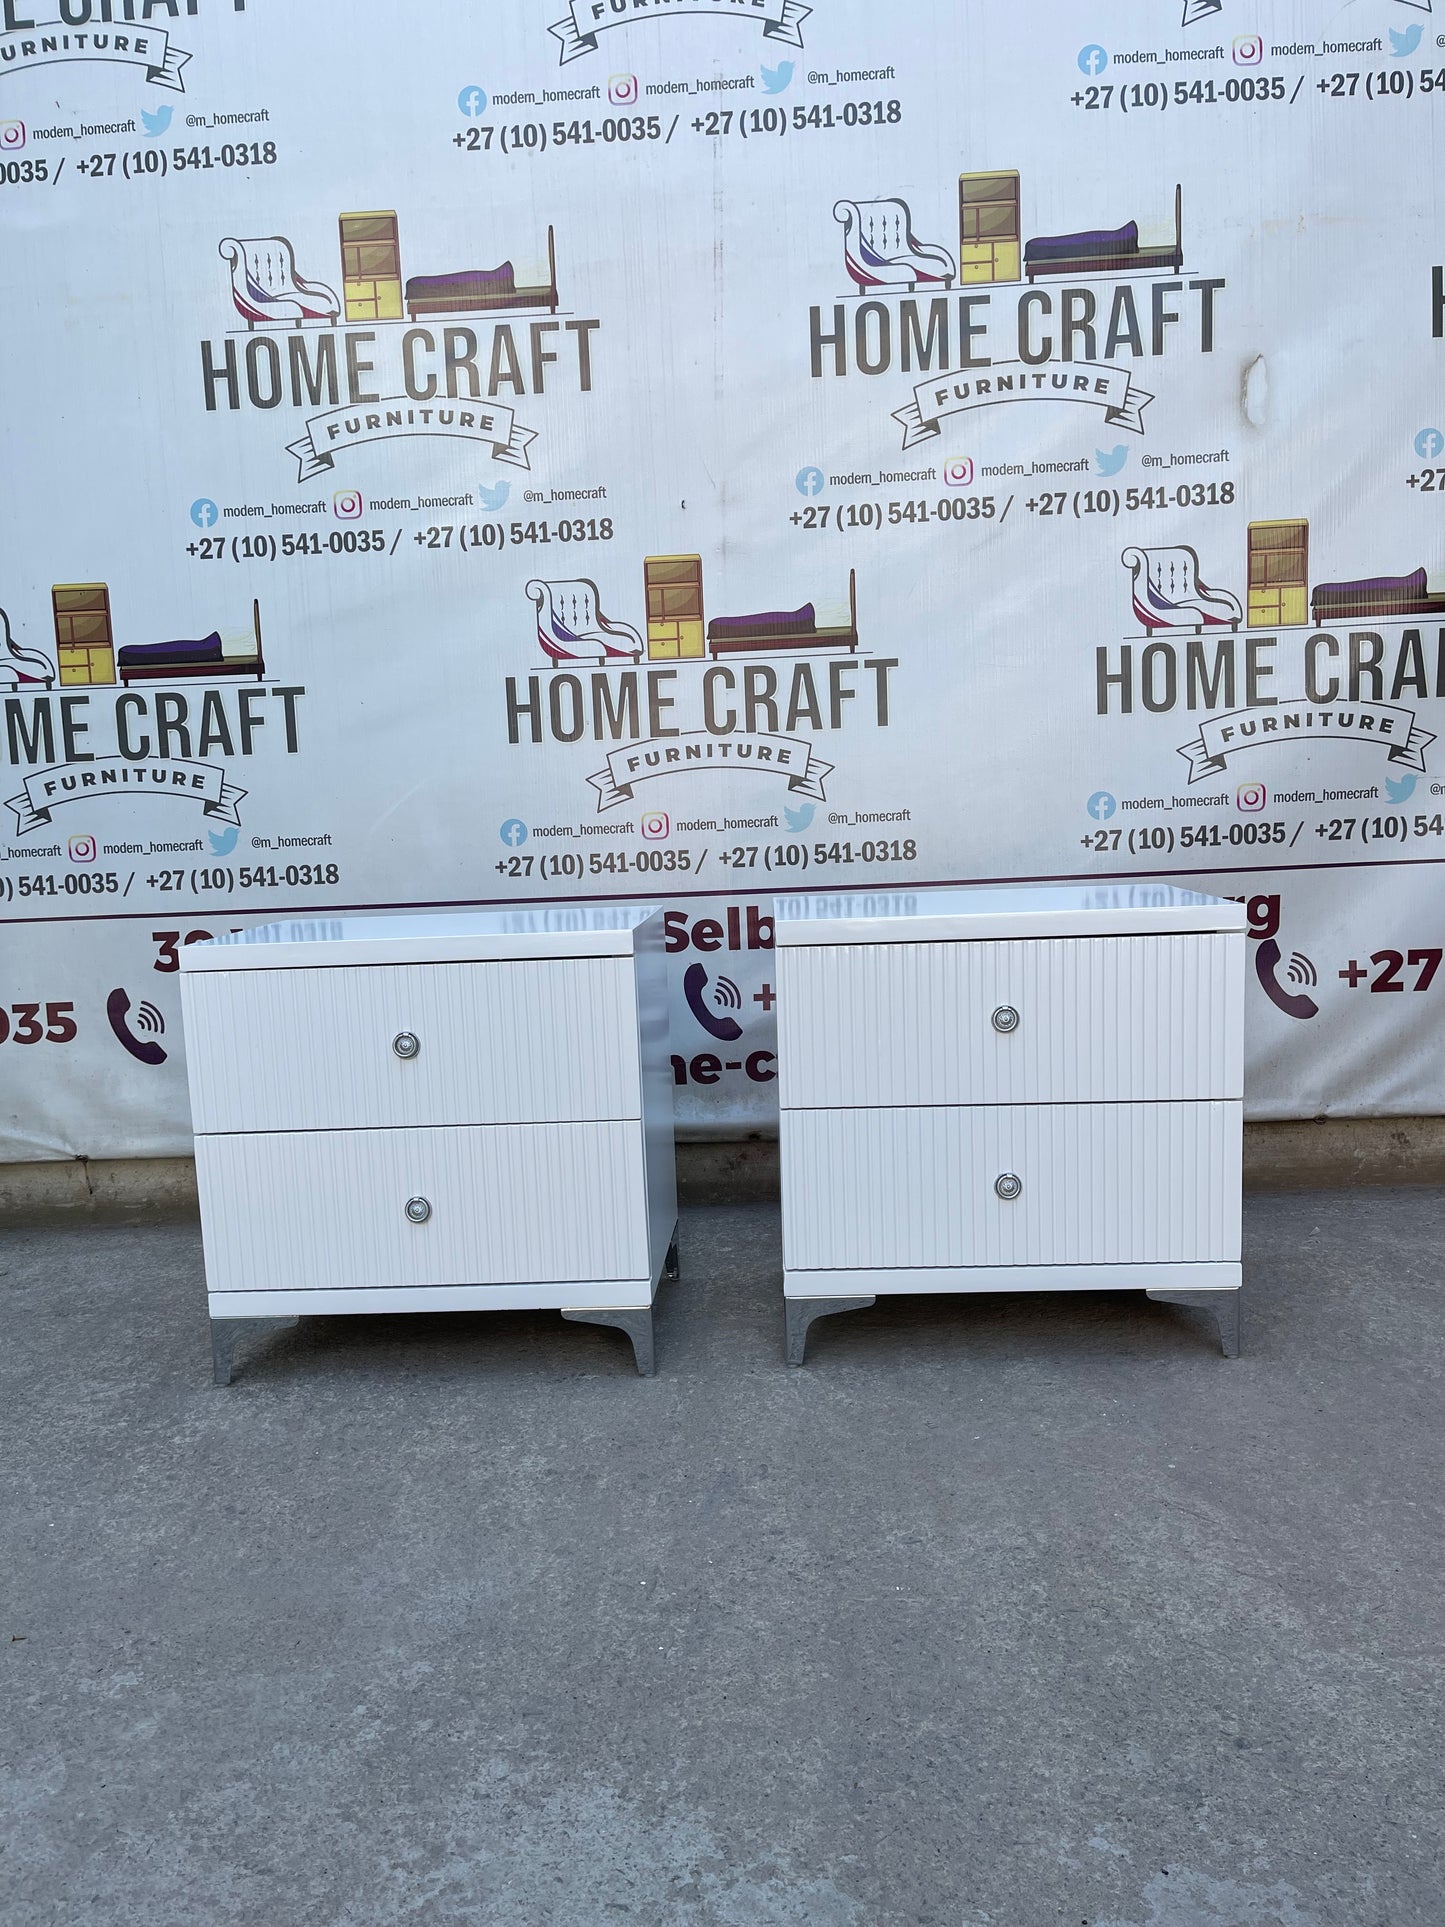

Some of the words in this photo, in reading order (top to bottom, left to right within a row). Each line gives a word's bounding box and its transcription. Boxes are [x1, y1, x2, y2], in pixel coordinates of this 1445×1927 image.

[807, 66, 896, 86] @m_homecraft
[1173, 76, 1286, 105] 541-0035
[185, 109, 270, 129] @m_homecraft
[552, 115, 661, 146] 541-0035
[792, 99, 901, 130] 541-0318
[173, 141, 278, 171] 541-0318
[809, 294, 992, 378] HOME
[1017, 278, 1226, 366] CRAFT
[200, 331, 381, 412] HOME
[401, 319, 600, 402] CRAFT
[934, 373, 1111, 408] FURNITURE
[326, 408, 496, 441] FURNITURE
[1141, 449, 1230, 469] @m_homecraft
[523, 485, 608, 505] @m_homecraft
[887, 496, 996, 526] 541-0035
[1124, 481, 1235, 512] 541-0318
[281, 529, 385, 558] 541-0035
[509, 517, 614, 545] 541-0318
[1096, 637, 1279, 715] HOME
[505, 669, 680, 744] HOME
[702, 657, 899, 736] CRAFT
[4, 695, 95, 765] ME
[115, 686, 305, 761] CRAFT
[1221, 712, 1395, 743] FURNITURE
[627, 742, 793, 773] FURNITURE
[44, 768, 206, 796] FURNITURE
[827, 808, 911, 827] @m_homecraft
[0, 845, 62, 861] _homecraft
[251, 833, 332, 850] @m_homecraft
[1180, 821, 1287, 848] 541-0035
[589, 848, 692, 875] 541-0035
[813, 838, 917, 865] 541-0318
[18, 872, 119, 896] 541-0035
[239, 863, 339, 889] 541-0318
[0, 1001, 77, 1044] 35
[1338, 948, 1444, 993] +27
